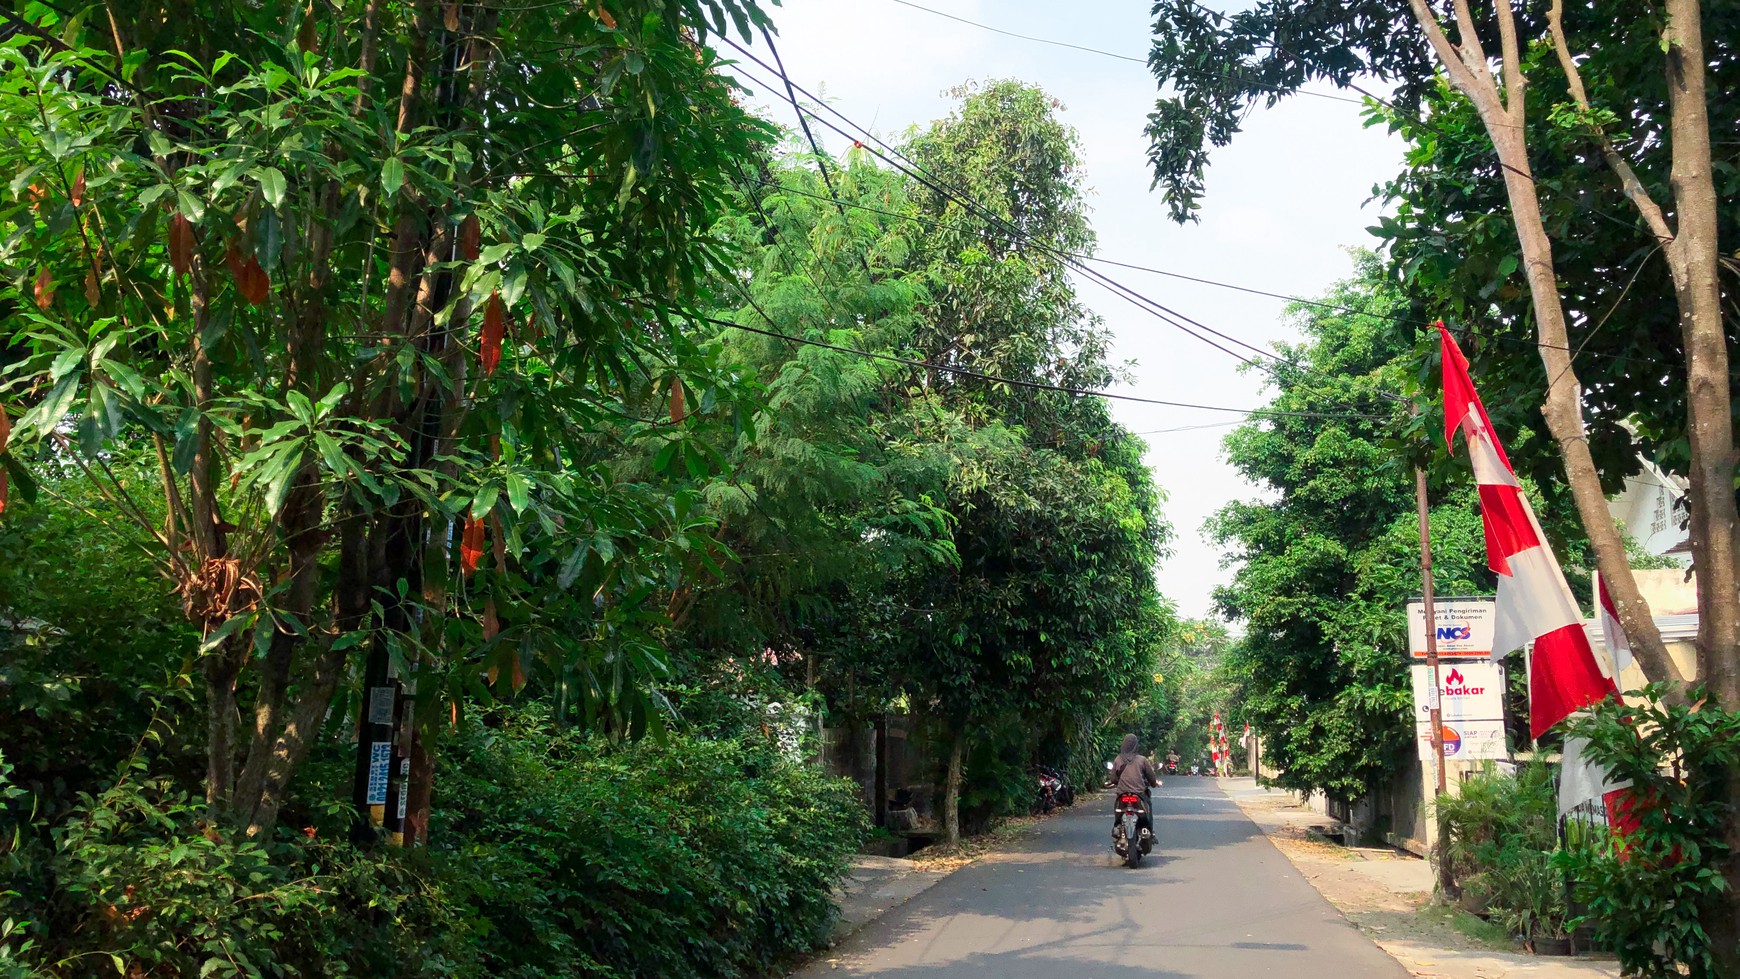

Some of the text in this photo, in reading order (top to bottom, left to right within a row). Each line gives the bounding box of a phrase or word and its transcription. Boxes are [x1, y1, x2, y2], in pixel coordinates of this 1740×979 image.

[1437, 626, 1471, 640] NCS
[1440, 684, 1485, 696] ebakar
[371, 744, 380, 764] WC
